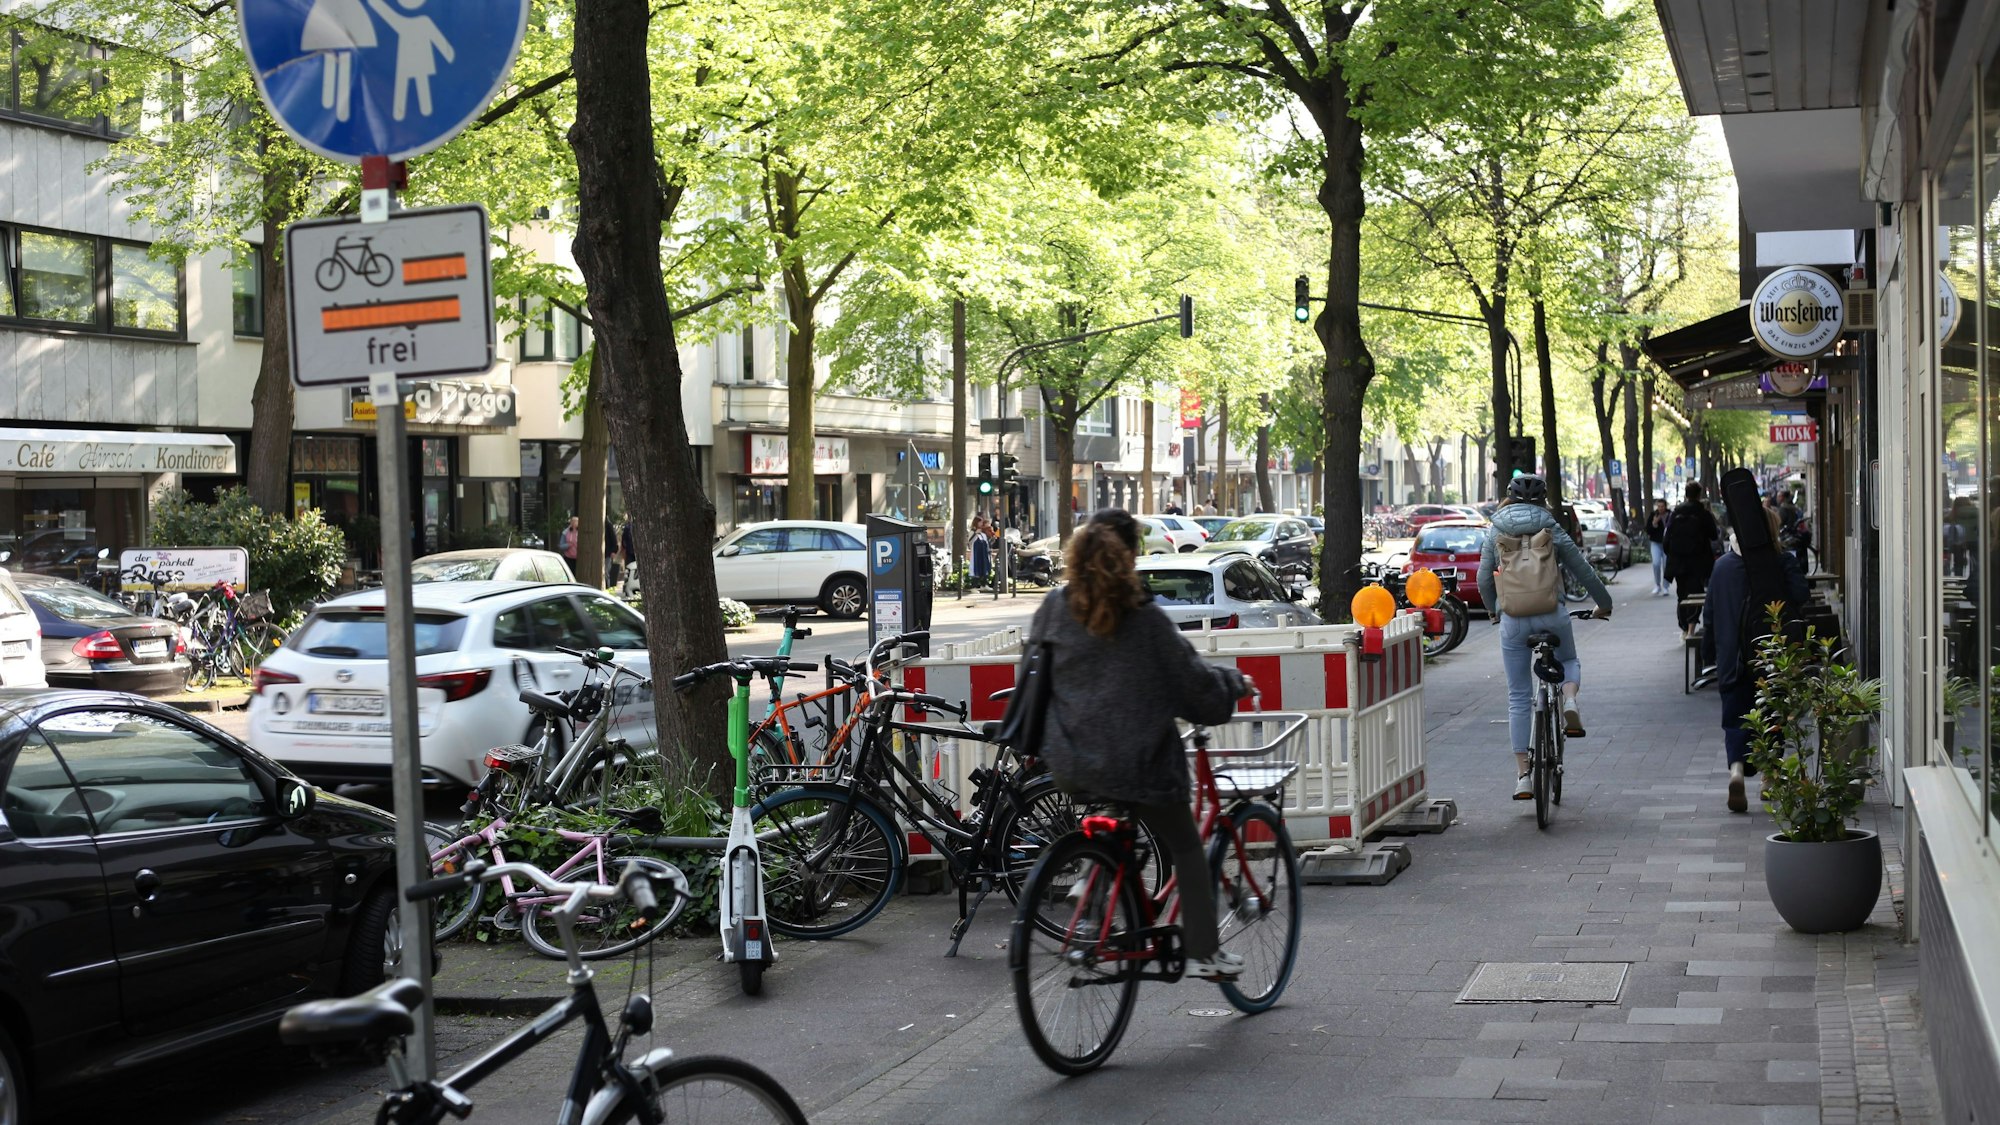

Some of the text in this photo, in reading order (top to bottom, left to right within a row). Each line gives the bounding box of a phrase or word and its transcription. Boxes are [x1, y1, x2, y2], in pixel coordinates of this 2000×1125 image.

[1766, 286, 1779, 299] SEIT
[1819, 285, 1831, 298] 1753
[1760, 298, 1839, 325] Warsteiner
[366, 333, 417, 365] frei
[1767, 328, 1831, 349] DAS EINZIG WAHRE
[441, 384, 512, 418] Prego
[1775, 427, 1812, 440] KIOSK
[17, 443, 228, 470] Café Hirsch Konditorei
[134, 553, 152, 562] der
[876, 541, 892, 567] P
